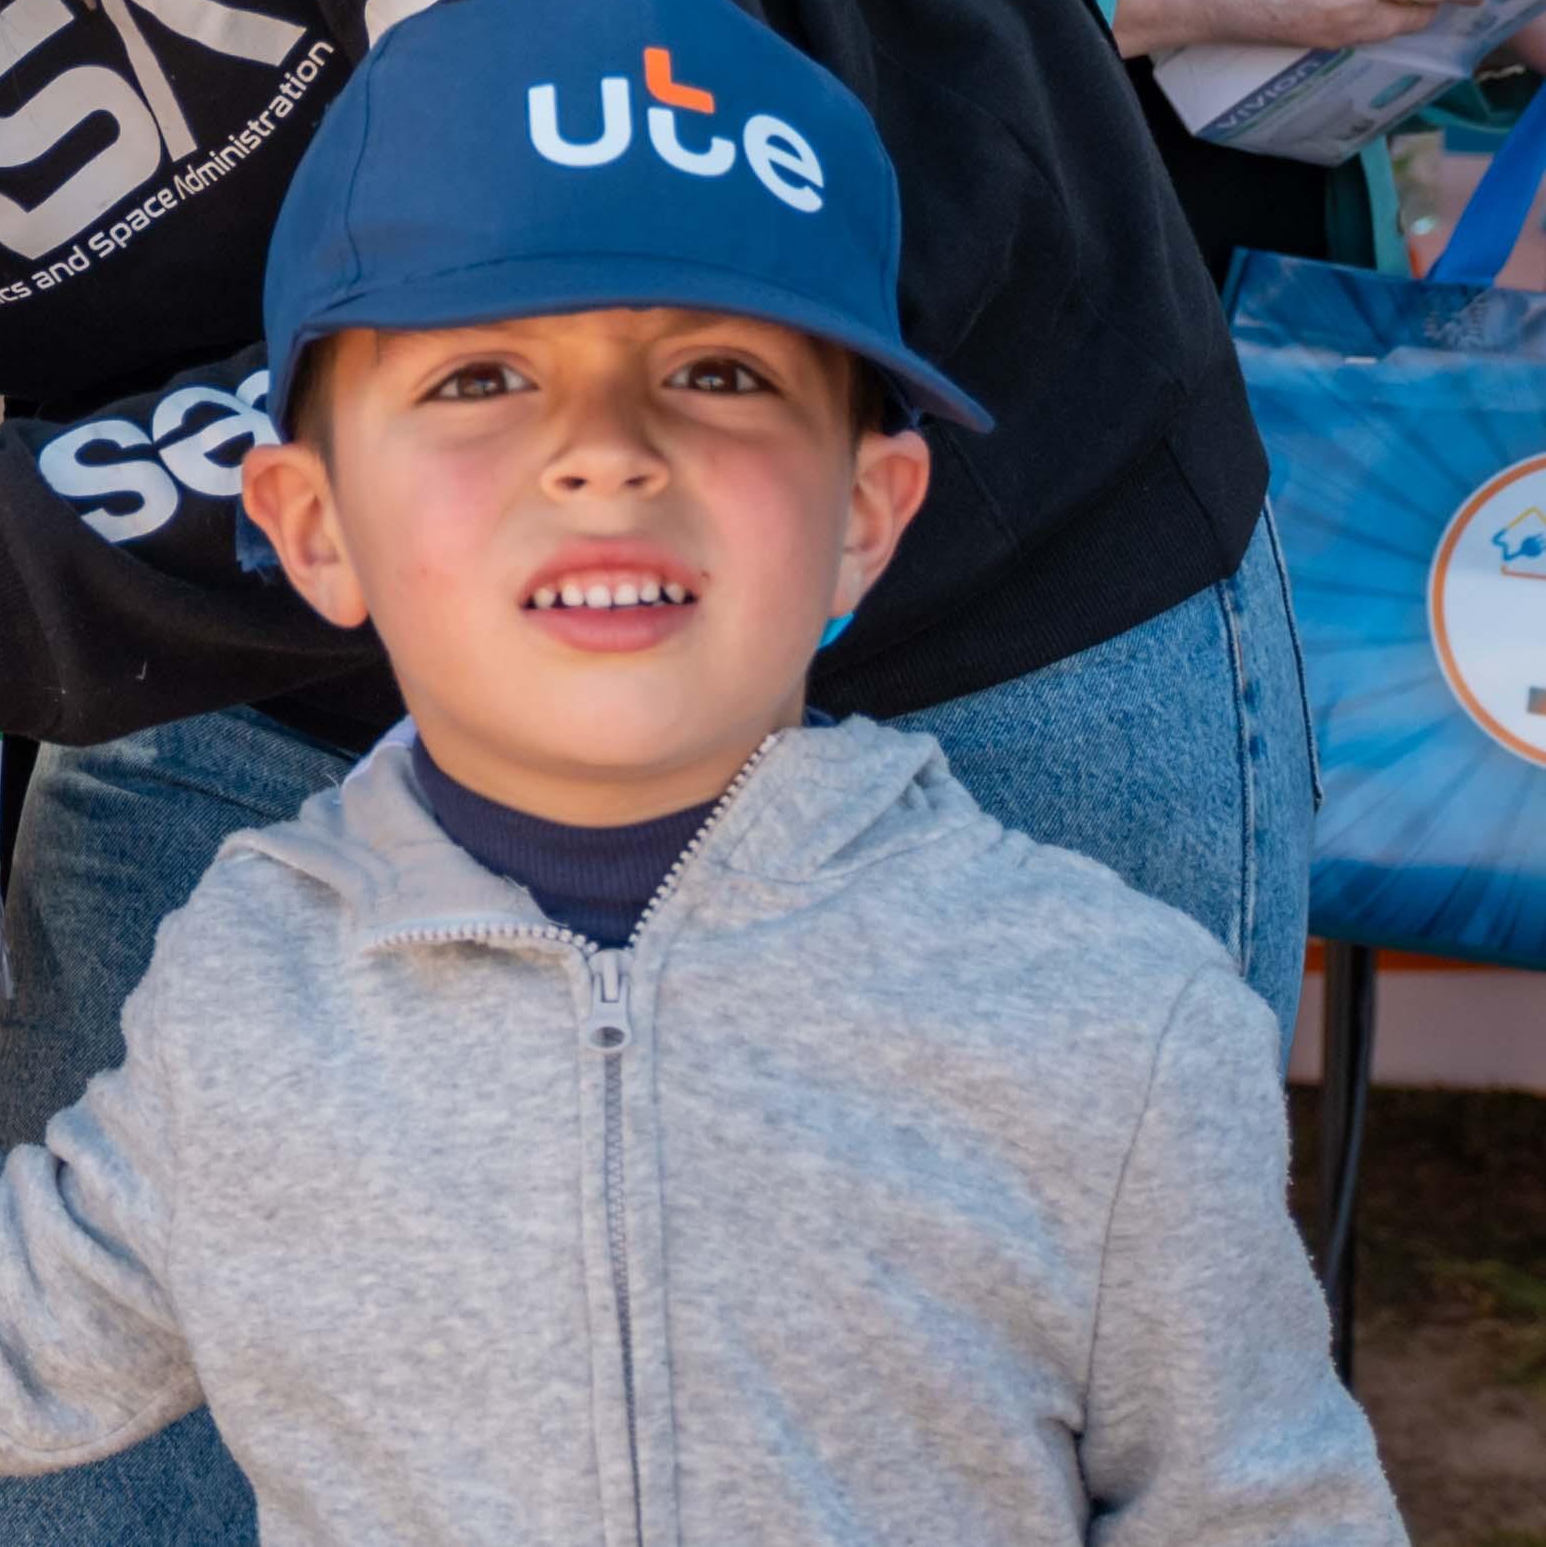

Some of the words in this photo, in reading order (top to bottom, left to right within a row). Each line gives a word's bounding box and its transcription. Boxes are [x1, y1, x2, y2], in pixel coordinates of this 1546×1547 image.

[32, 244, 91, 290] and
[88, 187, 178, 259] Space
[173, 40, 335, 201] Administration
[527, 46, 825, 214] ute
